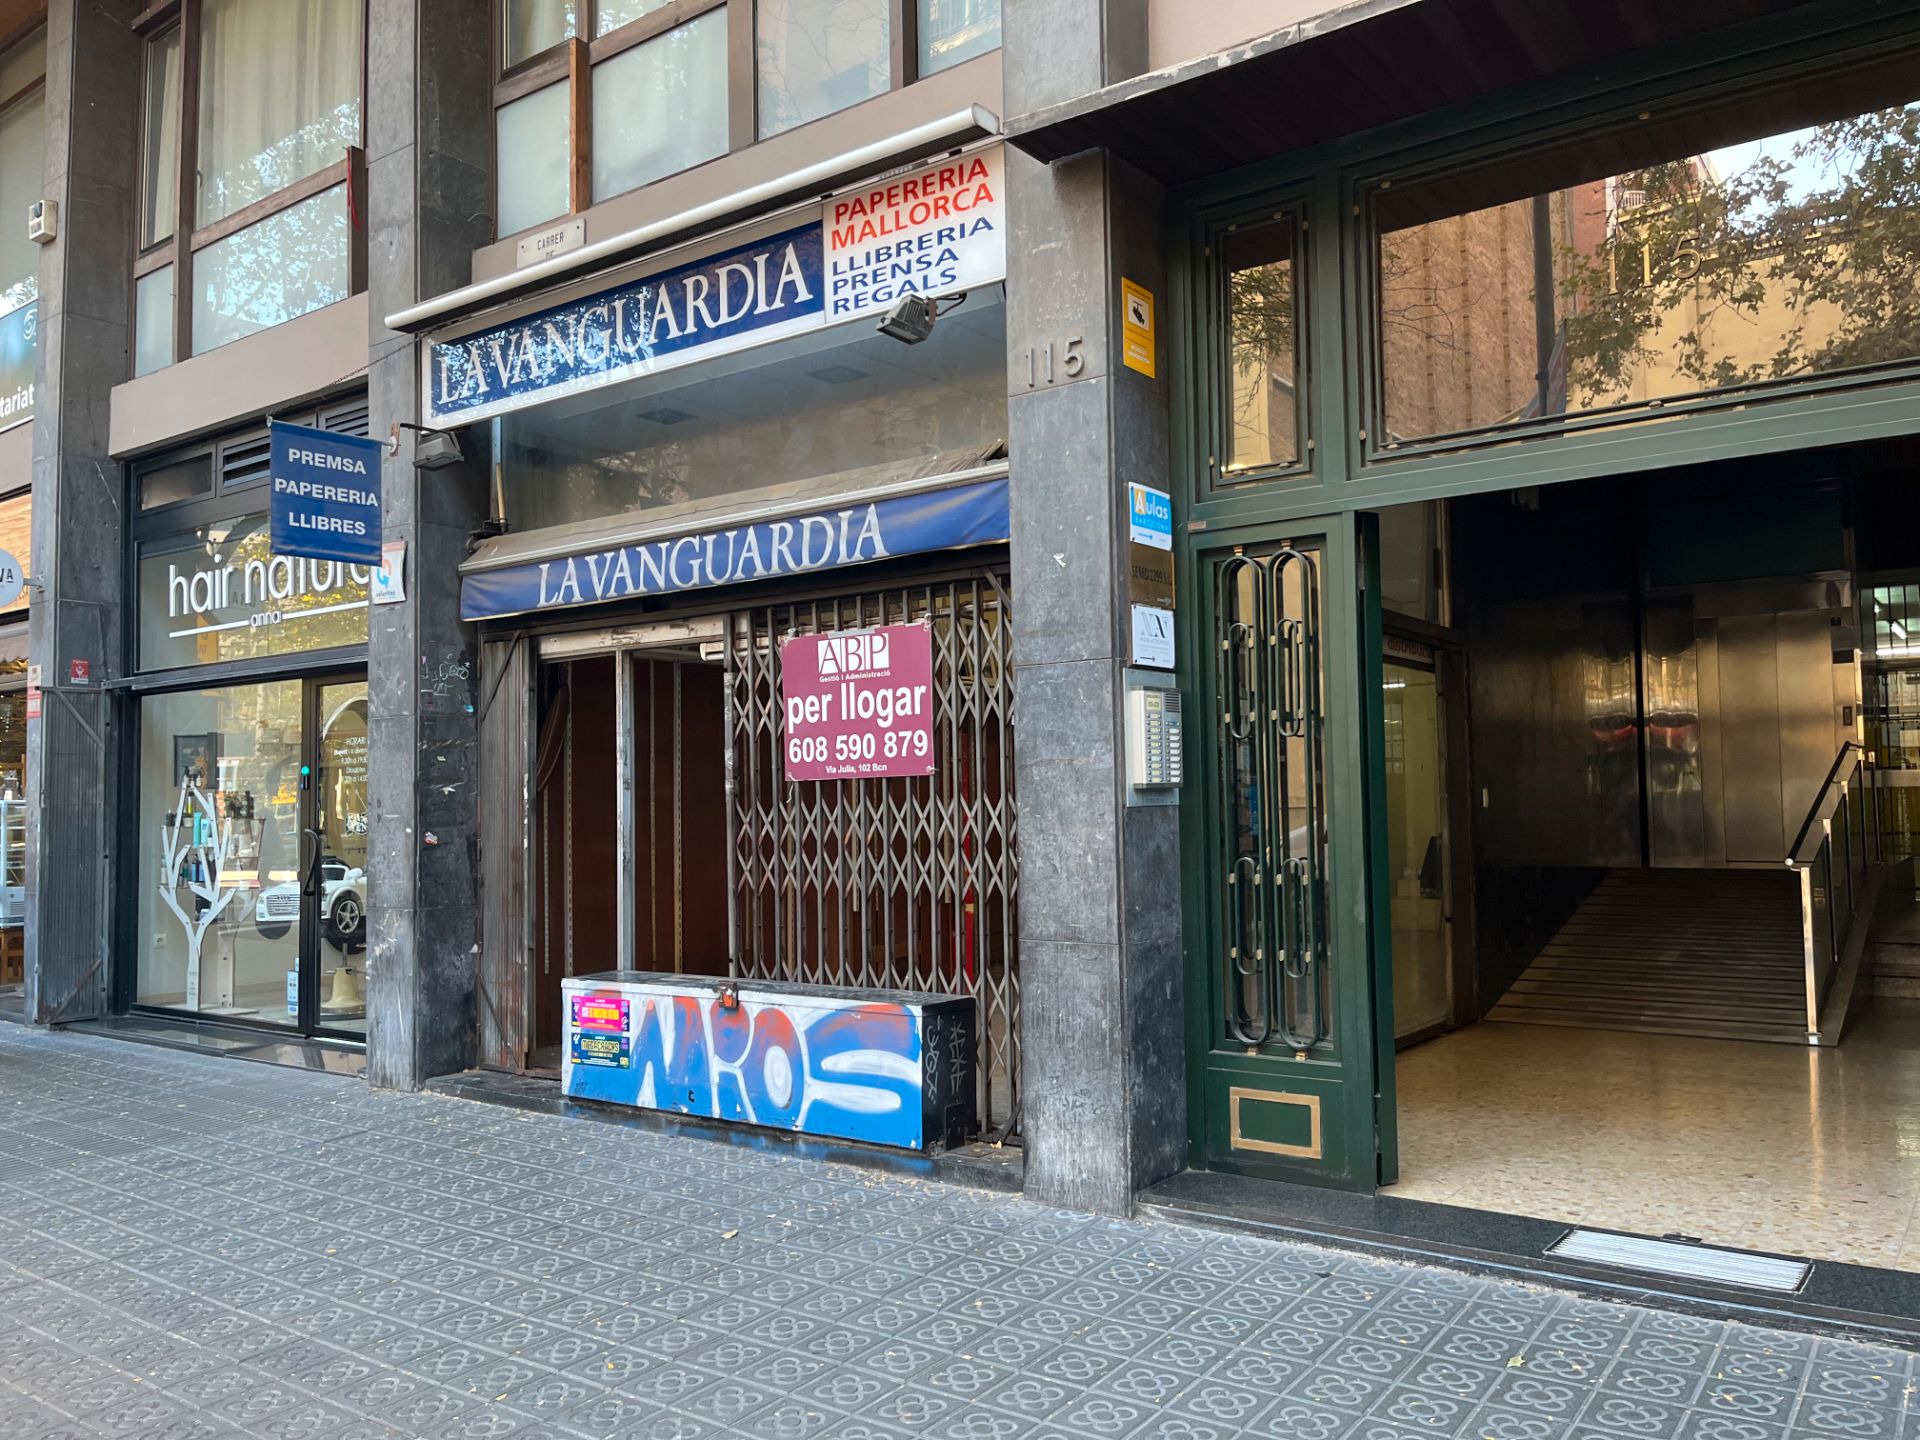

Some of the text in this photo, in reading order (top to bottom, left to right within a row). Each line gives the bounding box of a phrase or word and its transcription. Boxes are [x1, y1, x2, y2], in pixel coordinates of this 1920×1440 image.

[835, 158, 989, 225] PAPERERIA
[831, 183, 994, 250] MALLORCA
[537, 232, 564, 250] CARRER
[832, 216, 994, 276] LLIBRERIA
[1606, 230, 1701, 295] 115
[832, 248, 959, 296] PRENSA
[832, 267, 957, 315] REGALS
[1025, 336, 1085, 388] 115
[288, 448, 367, 475] PREMSA
[274, 478, 379, 507] PAPERERIA
[1135, 490, 1168, 520] Aulas
[288, 512, 366, 535] LLIBRES
[168, 553, 235, 617] hair
[817, 633, 890, 675] ABP
[819, 674, 840, 683] Gestió
[845, 670, 891, 680] Administració
[788, 682, 927, 734] per llogar
[789, 729, 928, 763] 608 590 879
[825, 765, 837, 774] Via
[858, 764, 871, 772] 102
[872, 763, 887, 772] Bcn
